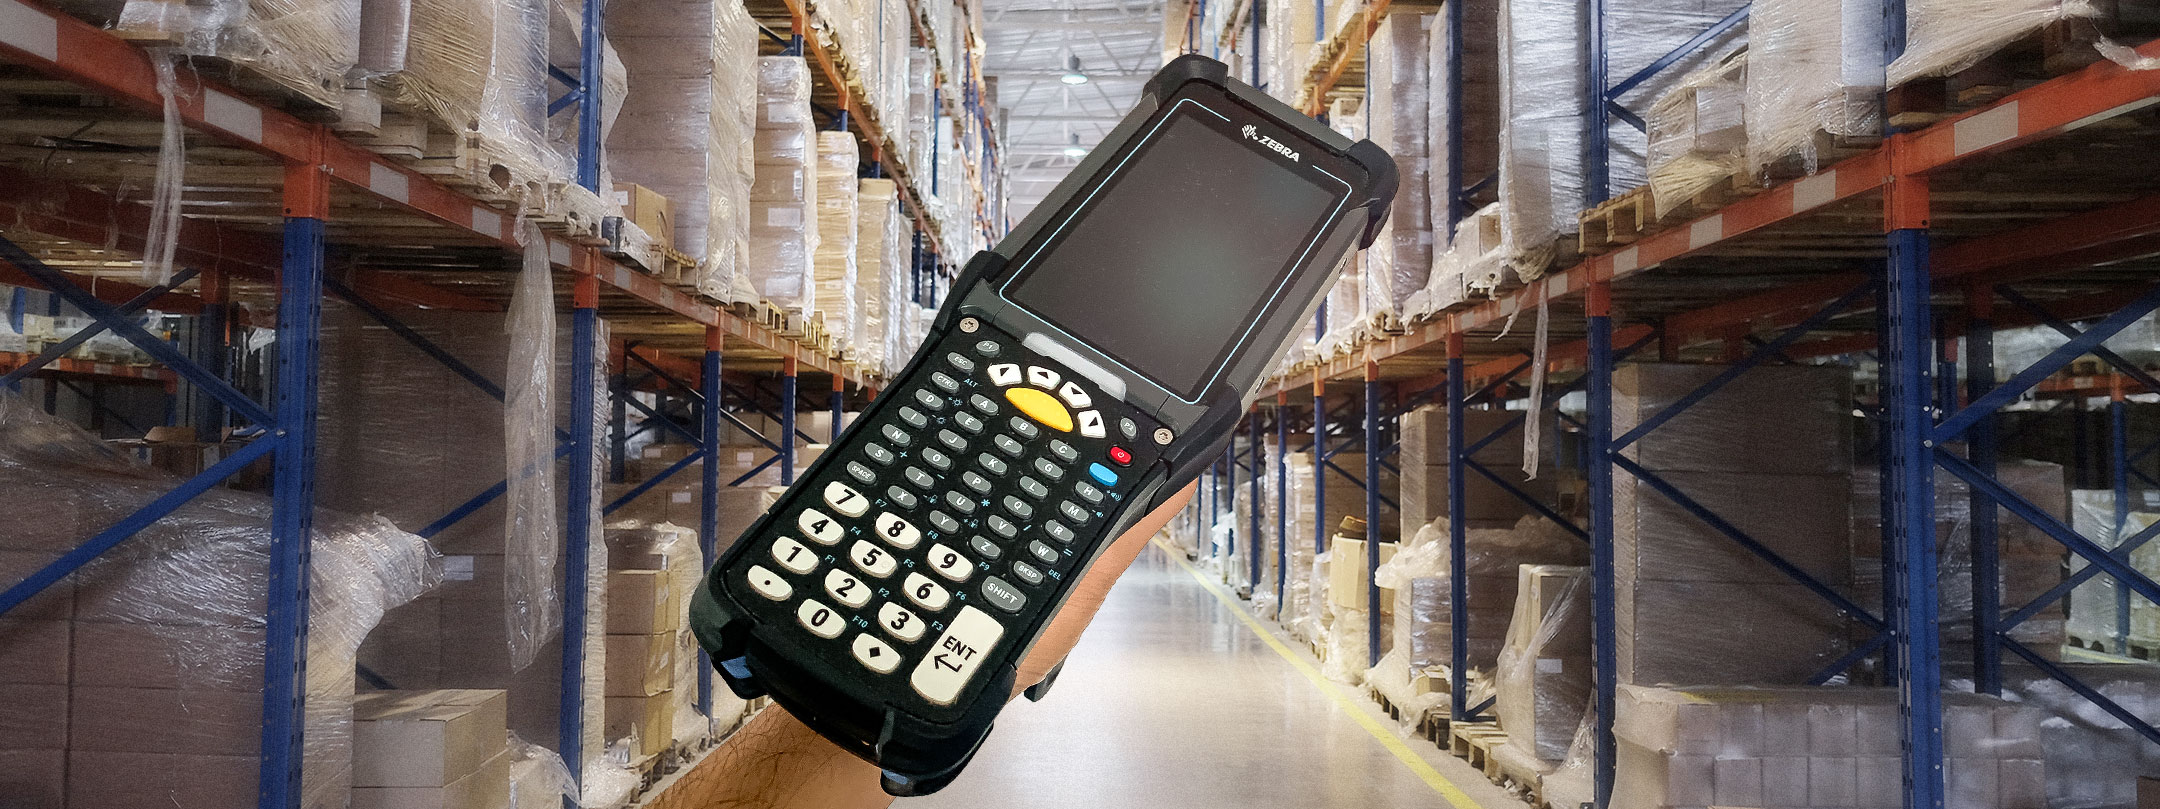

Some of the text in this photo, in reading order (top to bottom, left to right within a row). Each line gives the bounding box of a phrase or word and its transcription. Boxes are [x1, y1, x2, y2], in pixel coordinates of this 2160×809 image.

[1258, 136, 1300, 162] ZEBRA
[954, 356, 968, 366] ESC
[938, 375, 954, 388] CTRL
[964, 378, 978, 388] ALT
[980, 400, 988, 408] A
[964, 417, 974, 426] E
[1019, 422, 1027, 431] B
[892, 430, 902, 439] N
[1004, 440, 1012, 448] F
[874, 449, 884, 458] S
[1058, 446, 1067, 454] C
[988, 459, 998, 468] K
[1044, 464, 1052, 472] G
[852, 465, 872, 479] SPACE
[916, 472, 925, 480] T
[972, 477, 981, 485] P
[1029, 482, 1036, 490] L
[836, 488, 856, 505] 7
[897, 492, 908, 501] X
[1084, 488, 1093, 496] H
[875, 498, 887, 508] F7
[956, 496, 965, 506] U
[1014, 501, 1022, 510] Q
[1069, 506, 1079, 516] M
[940, 516, 950, 526] Y
[998, 521, 1008, 530] V
[811, 518, 830, 535] 4
[850, 526, 862, 536] F4
[887, 520, 906, 538] 8
[1054, 526, 1062, 535] R
[980, 541, 991, 552] Z
[1038, 546, 1049, 557] W
[786, 546, 802, 563] 1
[825, 554, 836, 564] F1
[863, 548, 882, 566] 5
[904, 558, 915, 568] F5
[940, 553, 958, 568] 9
[979, 562, 990, 571] F9
[1048, 569, 1061, 580] DEL
[836, 578, 856, 598] 2
[878, 588, 890, 598] F2
[916, 582, 934, 600] 6
[987, 582, 1018, 604] SHIFT
[956, 591, 966, 600] F6
[852, 615, 868, 628] F10
[890, 612, 910, 630] 3
[931, 620, 944, 631] F3
[943, 636, 977, 661] ENT
